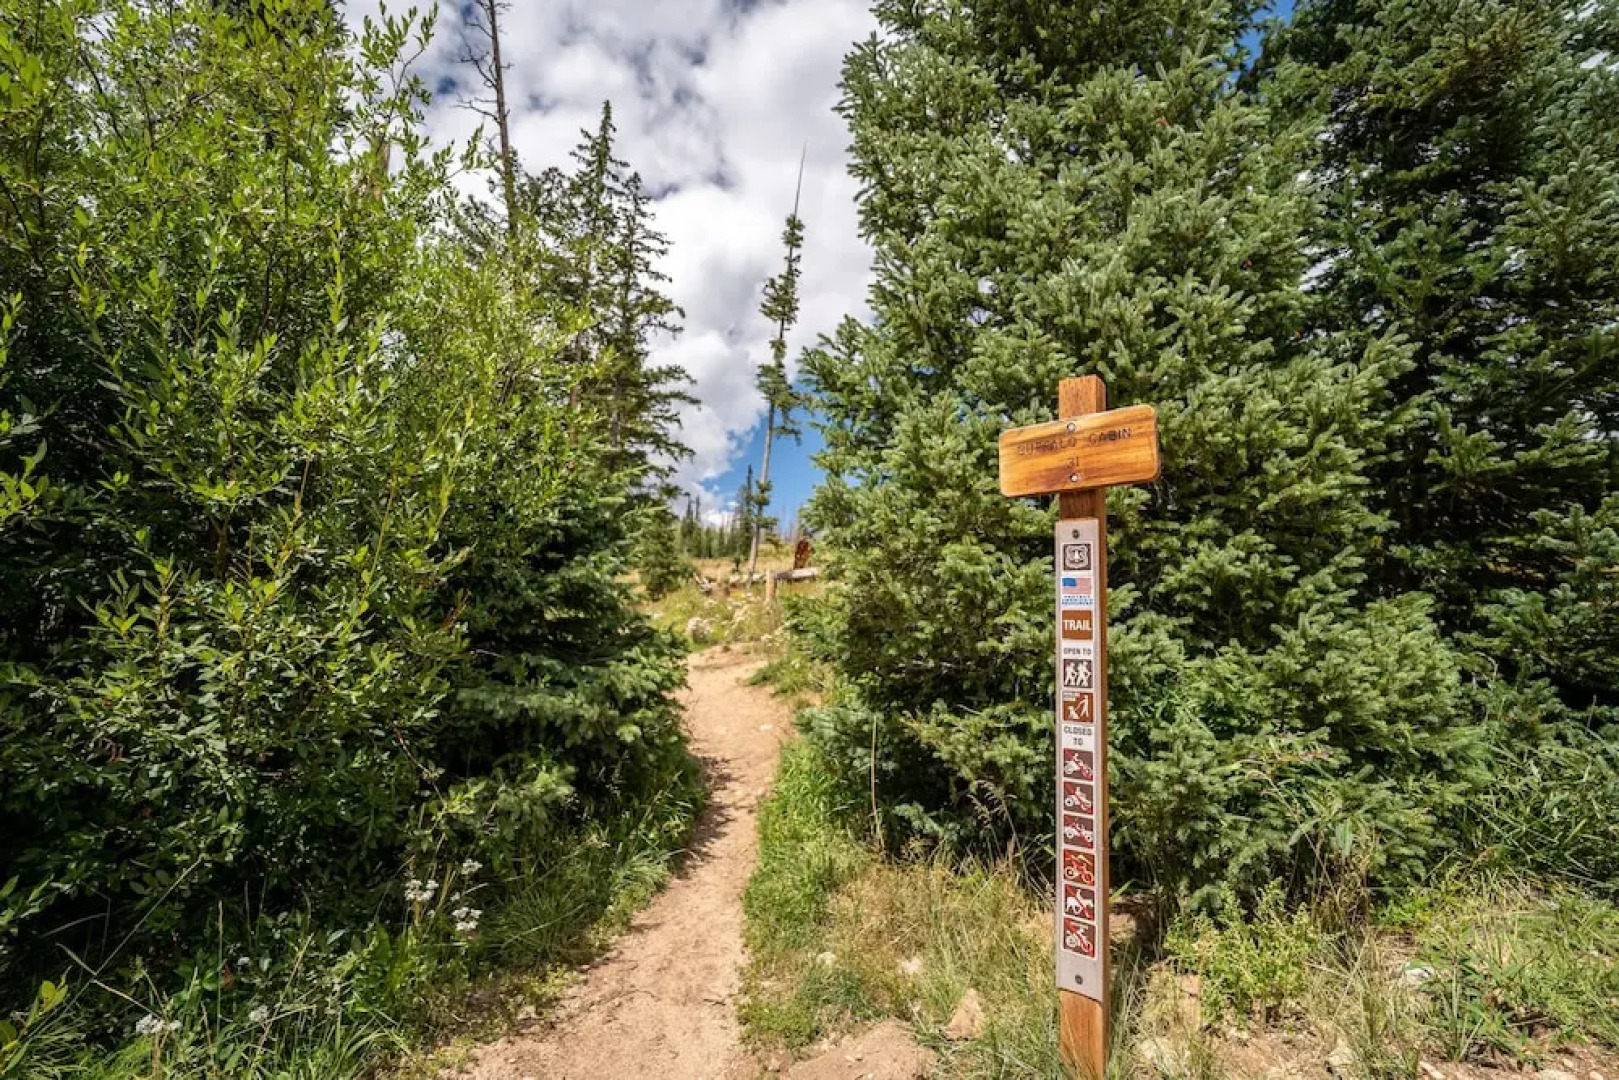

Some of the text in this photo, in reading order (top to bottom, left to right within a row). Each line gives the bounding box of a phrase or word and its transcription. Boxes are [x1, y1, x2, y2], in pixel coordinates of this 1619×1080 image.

[1019, 428, 1131, 455] BUFFALO CABIN
[1063, 619, 1091, 630] TRAIL
[1064, 647, 1081, 655] OPEN
[1064, 726, 1092, 736] CLOSED
[1073, 738, 1083, 746] TO
